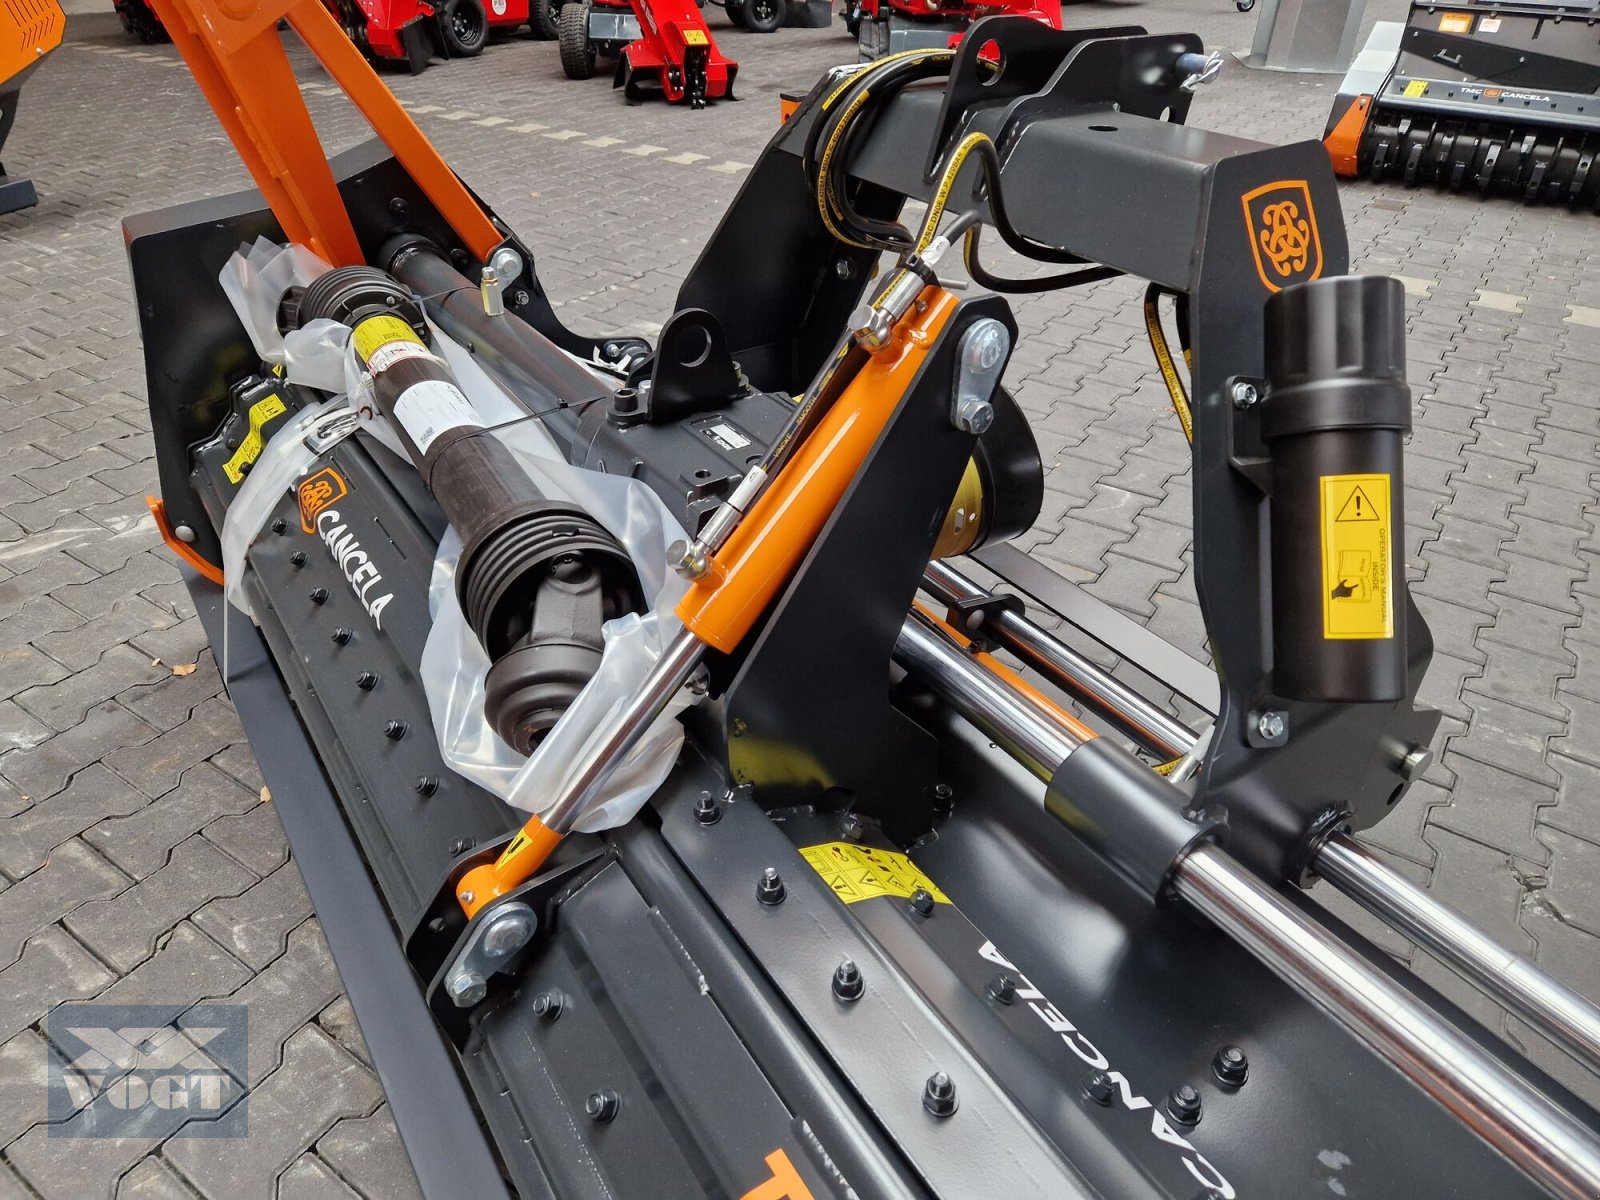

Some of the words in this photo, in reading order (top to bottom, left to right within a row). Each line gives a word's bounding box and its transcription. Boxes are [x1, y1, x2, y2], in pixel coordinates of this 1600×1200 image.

[1461, 87, 1483, 95] TMC
[1501, 91, 1550, 102] CANCELA
[922, 224, 935, 242] 2SC
[317, 510, 394, 631] CANCELA
[978, 940, 1235, 1200] CANCELA
